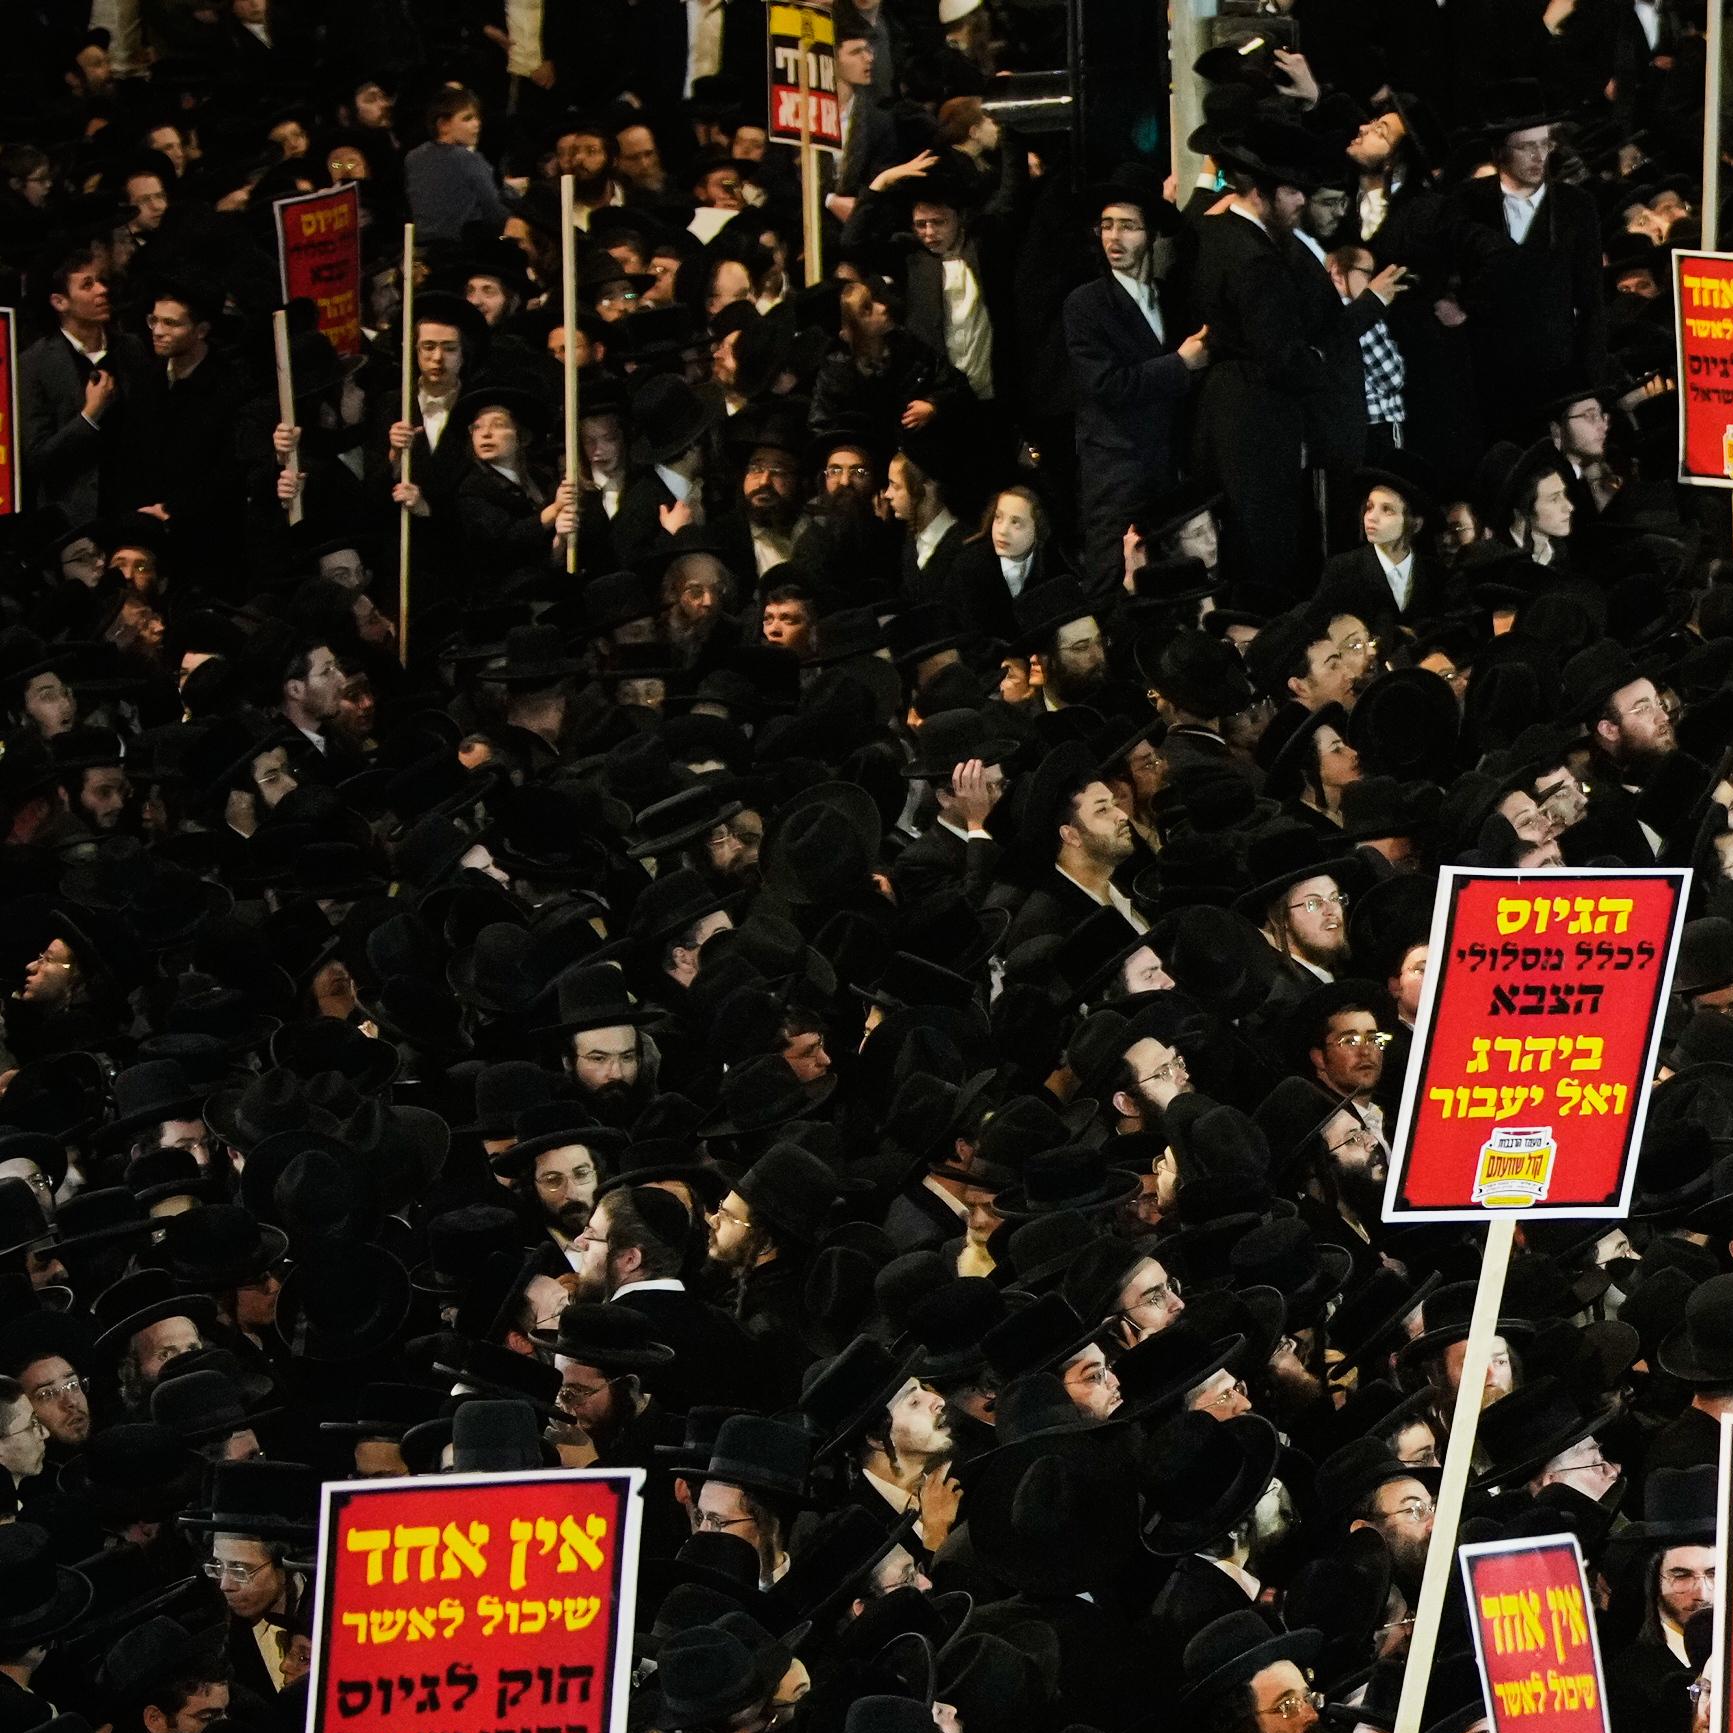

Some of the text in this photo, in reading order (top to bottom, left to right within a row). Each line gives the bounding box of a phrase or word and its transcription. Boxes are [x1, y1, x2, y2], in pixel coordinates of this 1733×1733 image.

[1497, 897, 1633, 935] הגיוס
[1456, 941, 1655, 972] לכלל מסלולי
[1489, 983, 1603, 1016] הצבא
[1466, 1034, 1605, 1073] ביהרג
[1429, 1077, 1627, 1121] ואל יעבור
[1526, 1153, 1543, 1179] קול
[346, 1513, 608, 1591] אין אחד
[342, 1595, 601, 1645] שיכול לאשר
[1481, 1583, 1588, 1664] אין אחד
[337, 1662, 594, 1719] חוק לגיוס
[1494, 1670, 1595, 1717] שיכול לאשר
